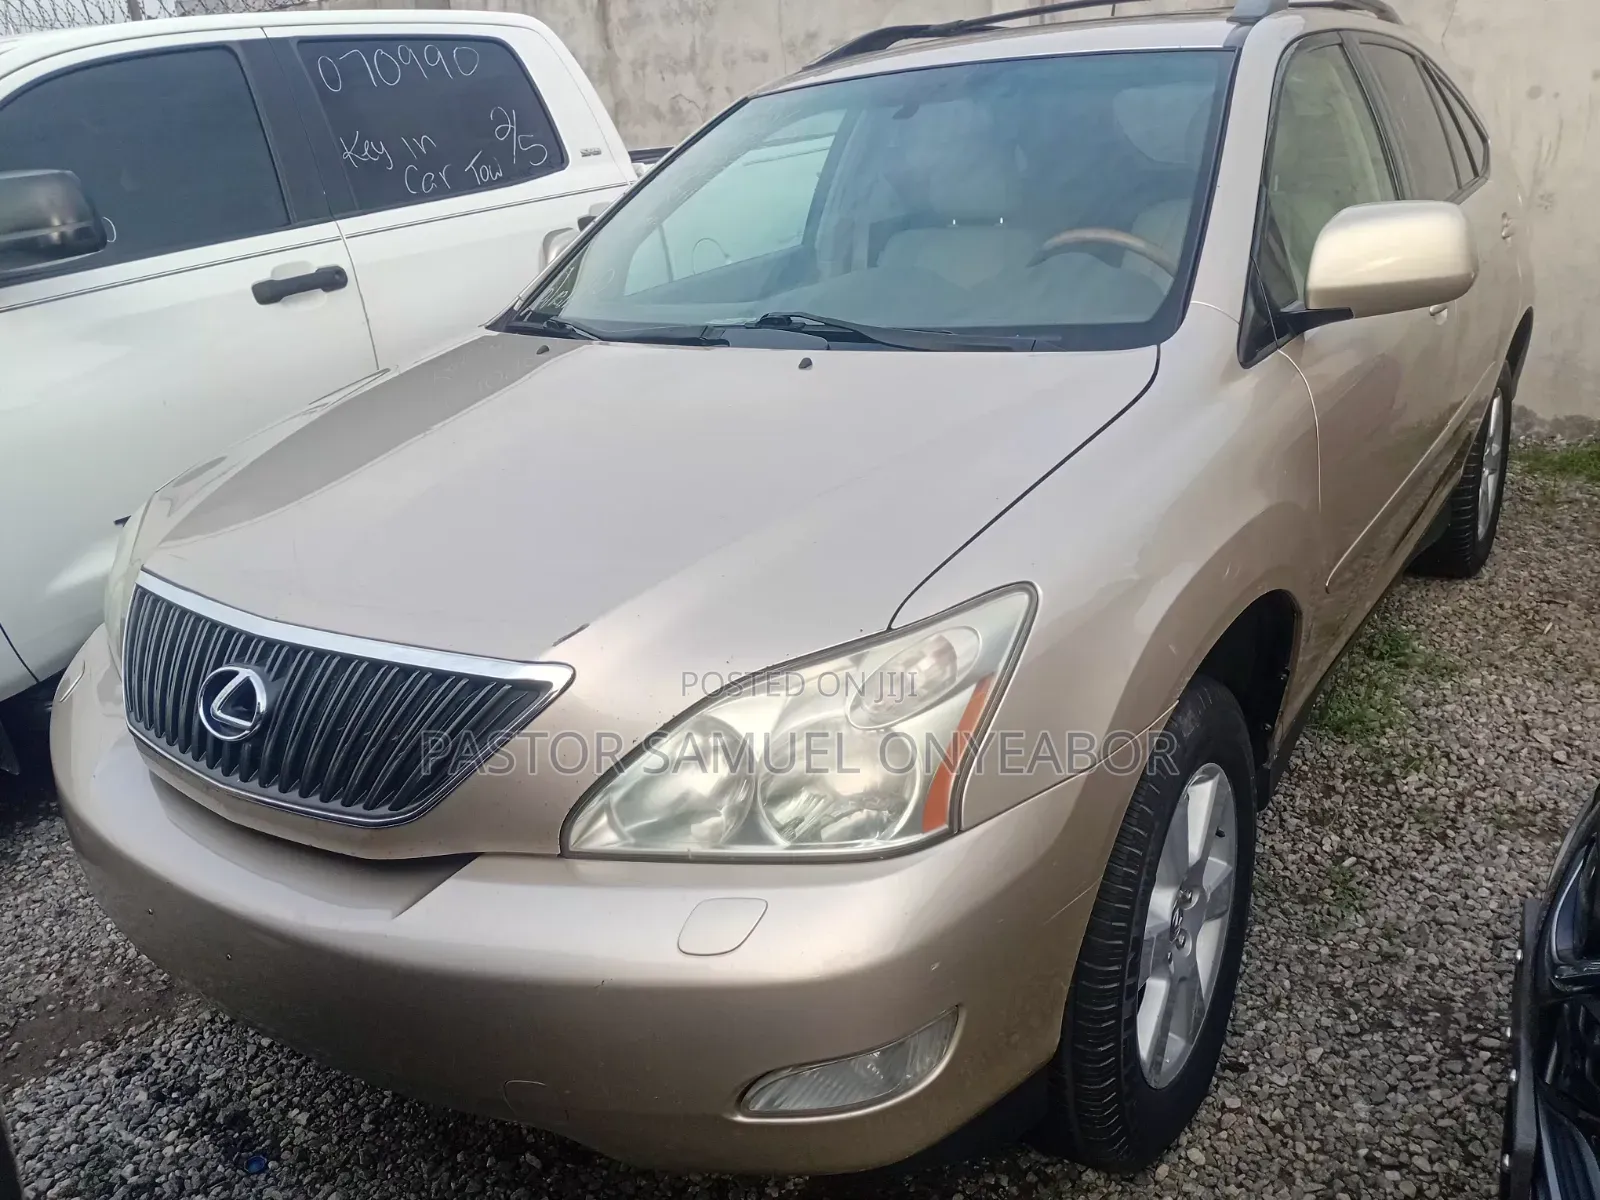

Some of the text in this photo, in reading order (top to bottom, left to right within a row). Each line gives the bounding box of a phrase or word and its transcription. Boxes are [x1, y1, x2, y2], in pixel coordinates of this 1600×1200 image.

[317, 44, 480, 93] 070990
[339, 130, 394, 170] Key
[403, 164, 451, 194] Car
